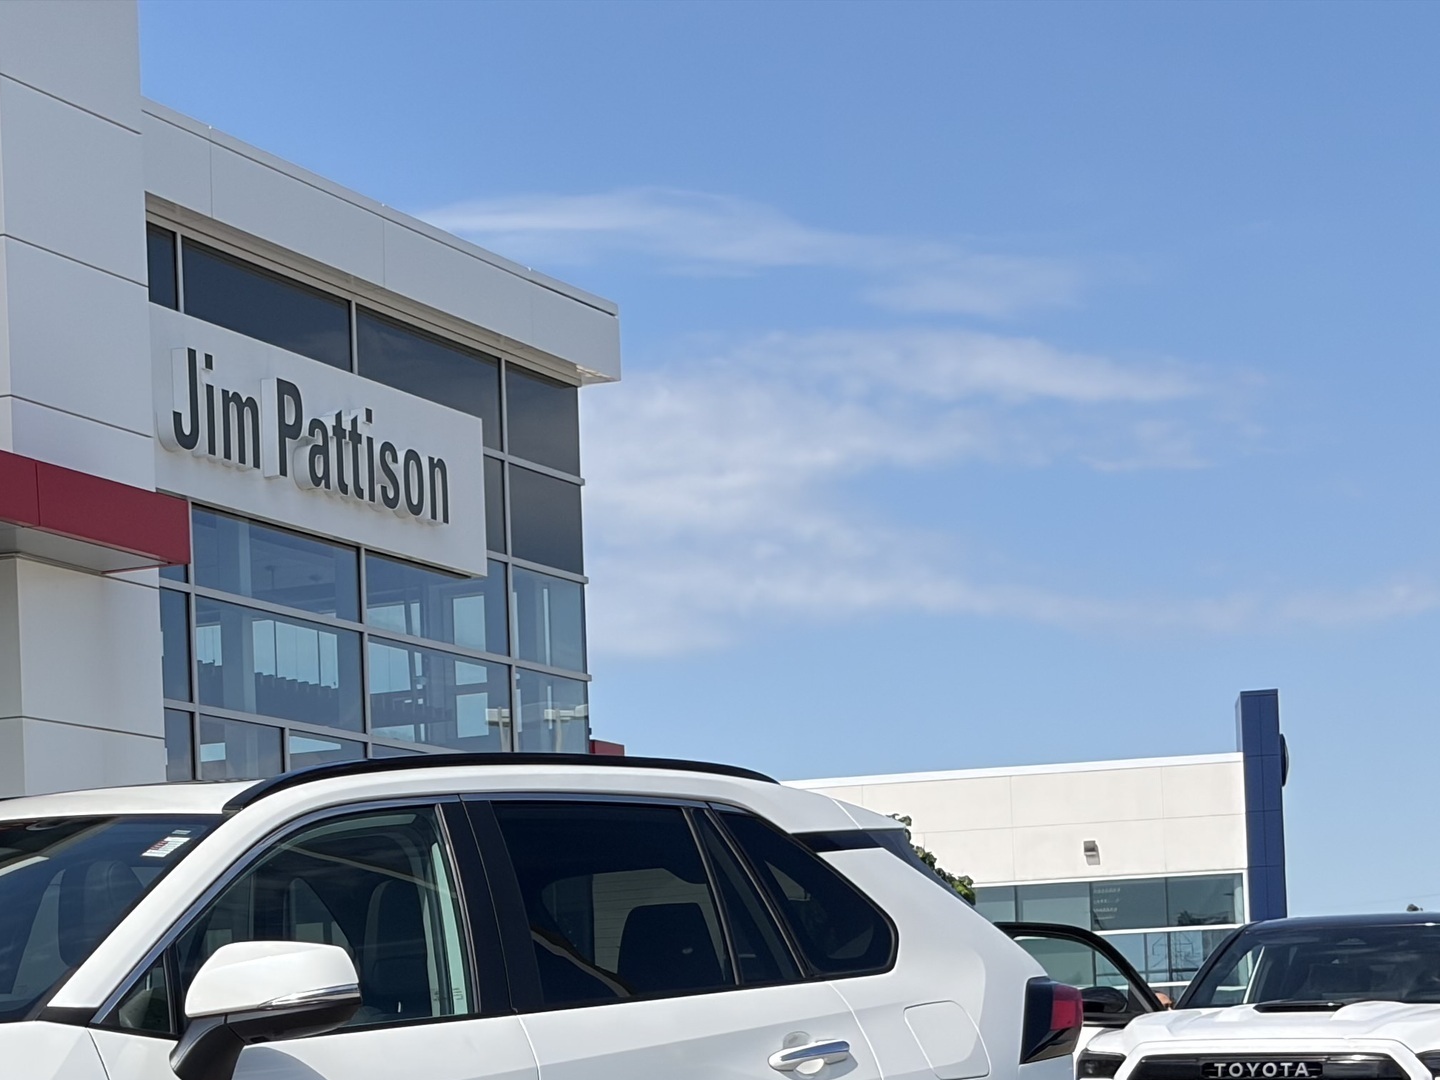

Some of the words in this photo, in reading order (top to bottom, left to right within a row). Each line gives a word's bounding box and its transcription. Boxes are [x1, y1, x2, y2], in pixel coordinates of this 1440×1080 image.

[172, 347, 260, 470] Jim
[276, 377, 449, 525] Pattison
[1213, 1062, 1309, 1078] TOYOTA
